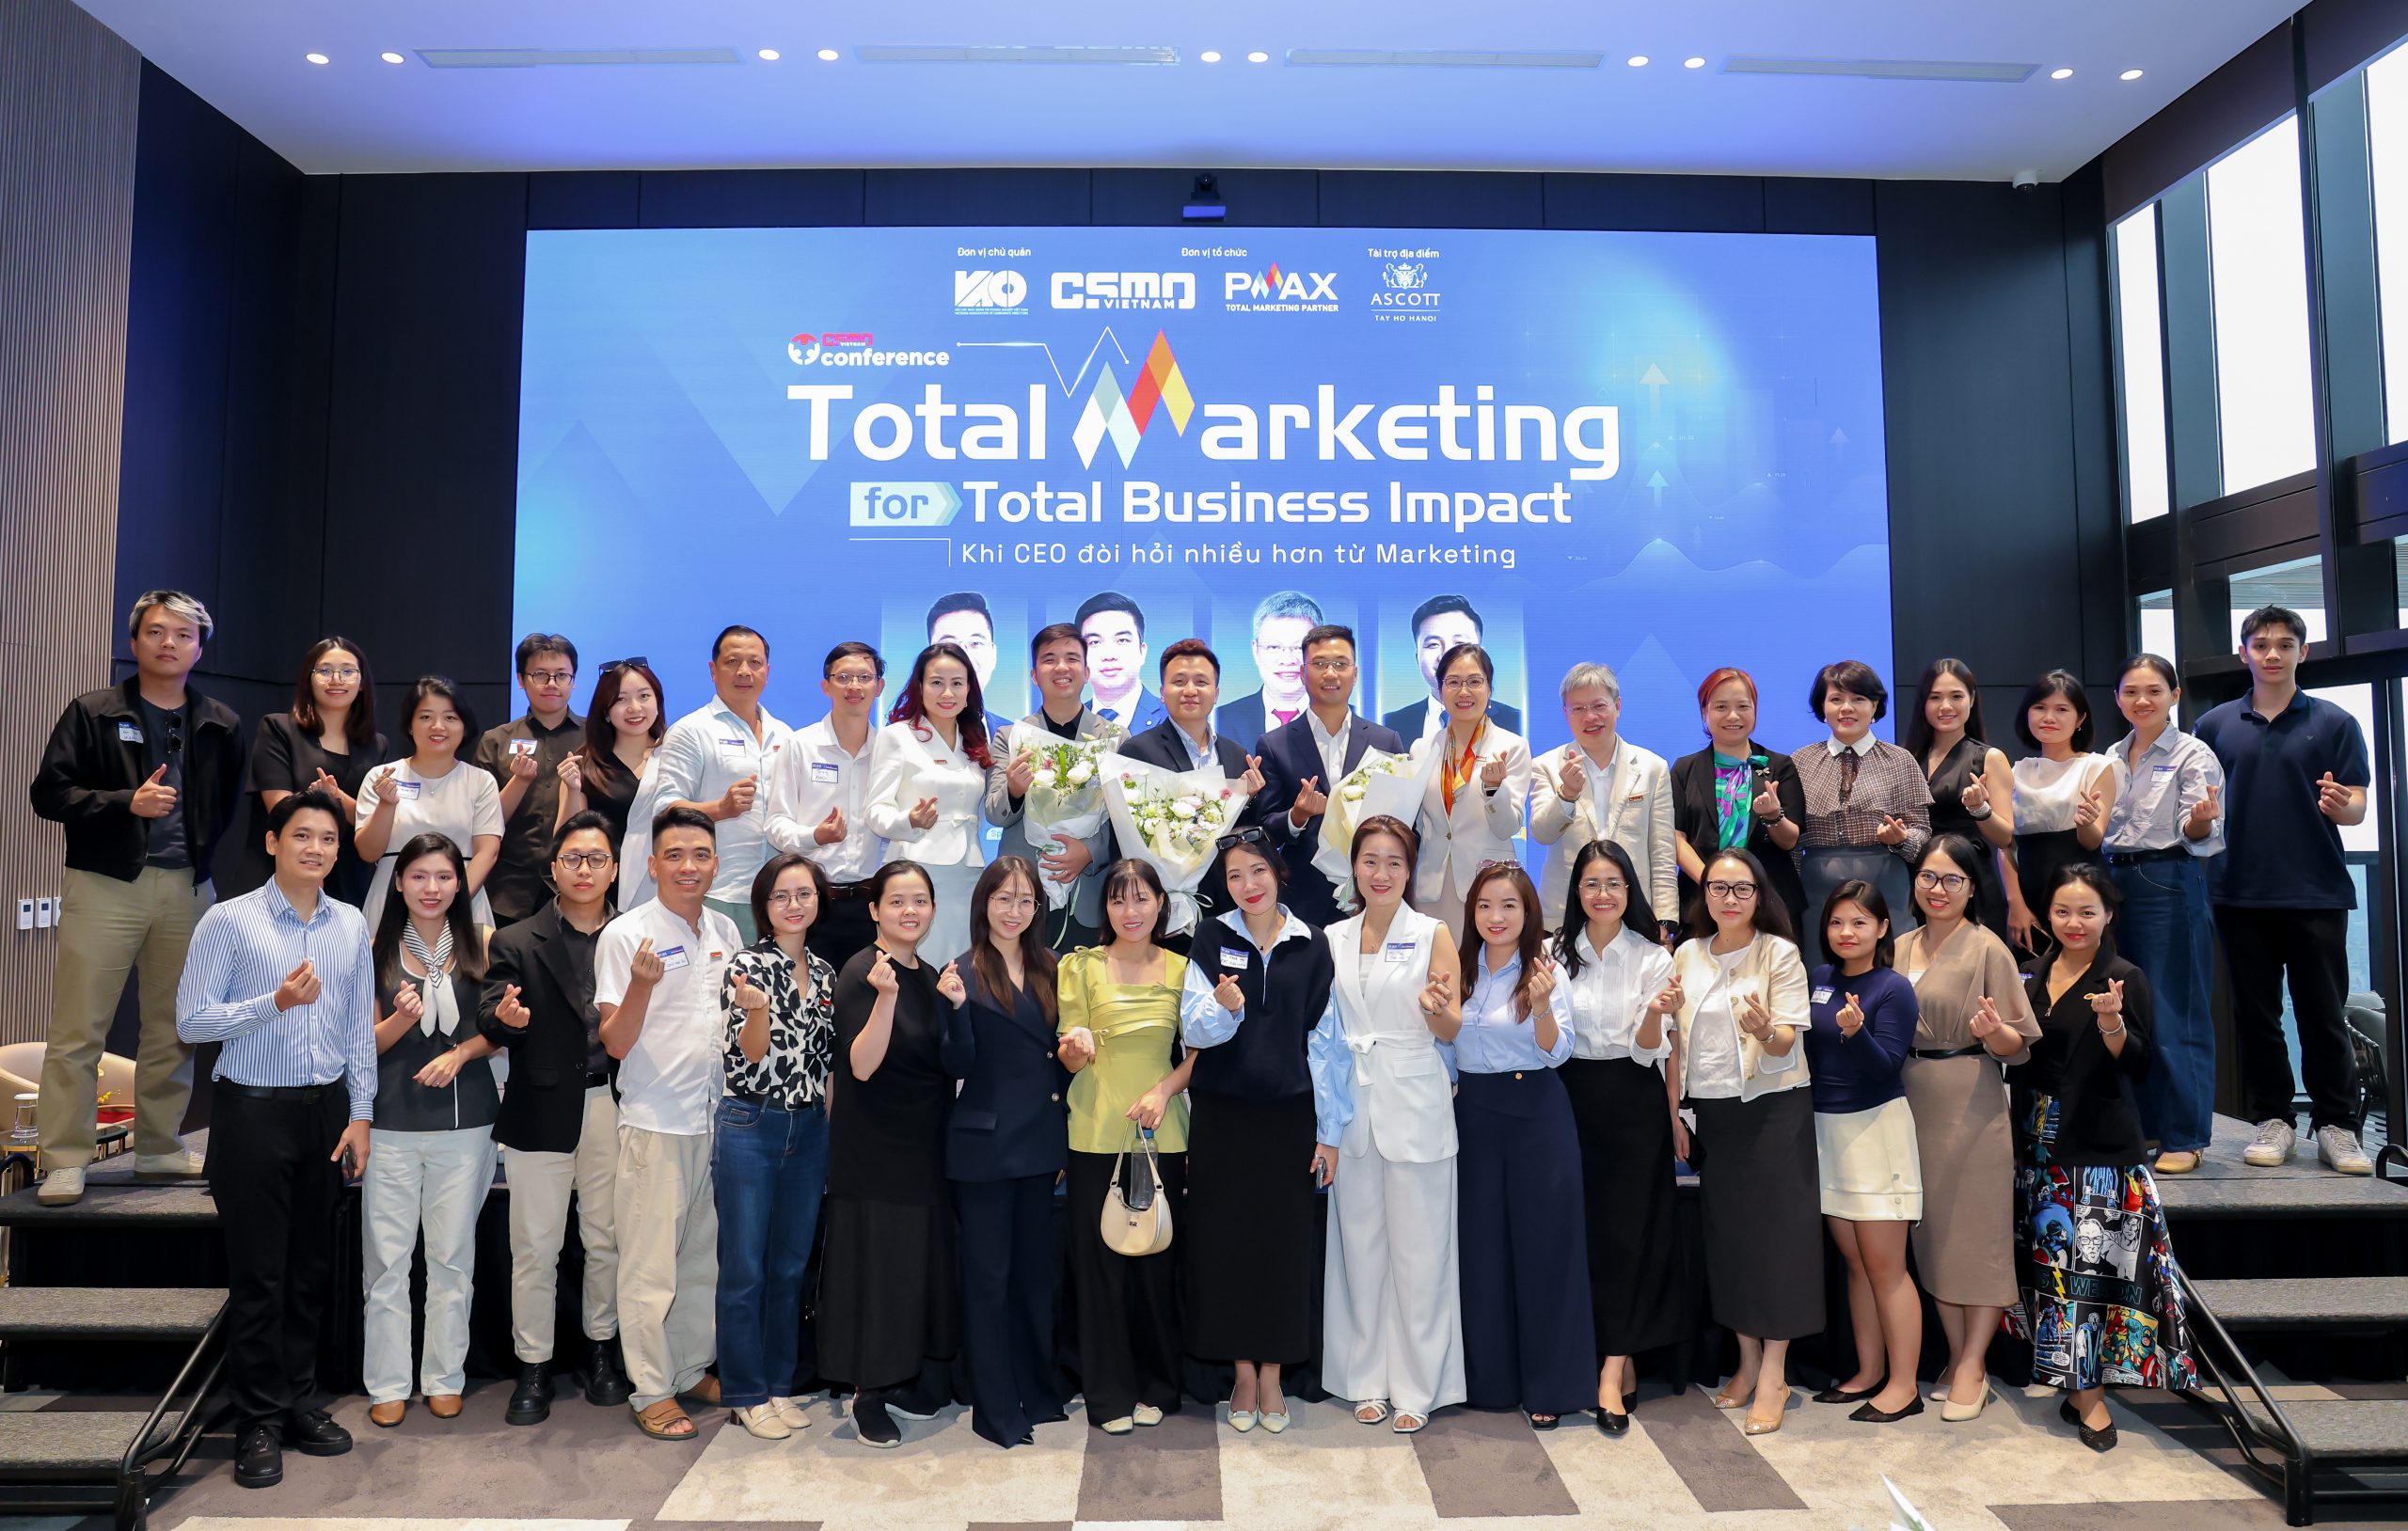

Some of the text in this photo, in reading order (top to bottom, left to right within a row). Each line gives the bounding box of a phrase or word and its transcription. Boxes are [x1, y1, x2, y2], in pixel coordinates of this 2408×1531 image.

[958, 246, 975, 257] Đơn
[978, 247, 987, 259] vị
[1181, 245, 1248, 259] Đơn vị tổ chức
[1368, 248, 1382, 258] Tài
[1384, 248, 1398, 260] trợ
[1400, 248, 1415, 260] địa
[1103, 299, 1175, 309] VIETNAM
[1370, 292, 1441, 307] ASCOTT
[1226, 304, 1339, 312] TOTAL MARKETING PARTNER
[820, 347, 950, 367] conference
[787, 384, 1047, 462] Total
[863, 481, 1572, 533] for Total Business Impact
[962, 540, 1515, 569] Khi CEO đòi hỏi nhiều hơn từ Marketing
